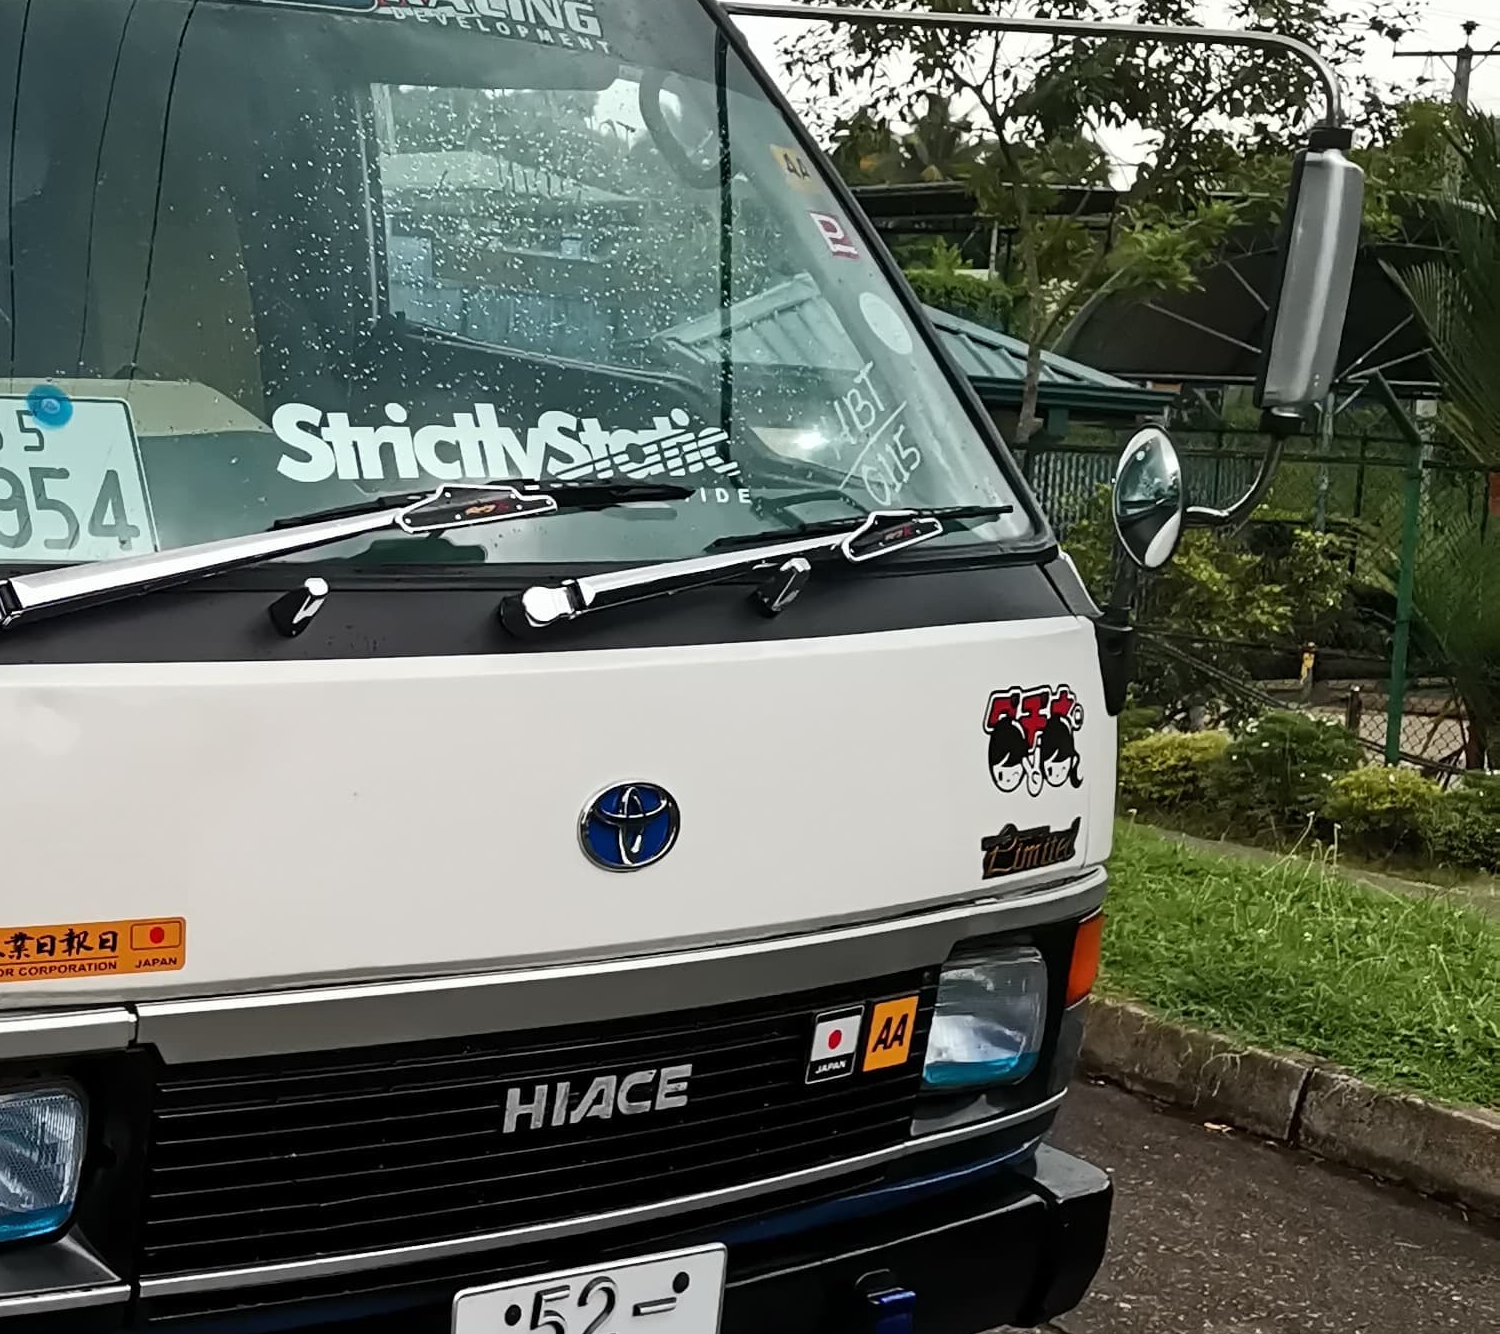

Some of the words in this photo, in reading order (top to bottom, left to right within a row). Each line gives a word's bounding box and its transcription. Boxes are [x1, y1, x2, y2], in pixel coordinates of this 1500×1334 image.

[390, 6, 612, 55] DEVELOPMENT
[18, 960, 118, 977] CORPORATION
[135, 956, 178, 969] JAPAN
[871, 1012, 909, 1053] AA
[814, 1059, 848, 1074] JAPAN
[502, 1063, 693, 1134] HIACE
